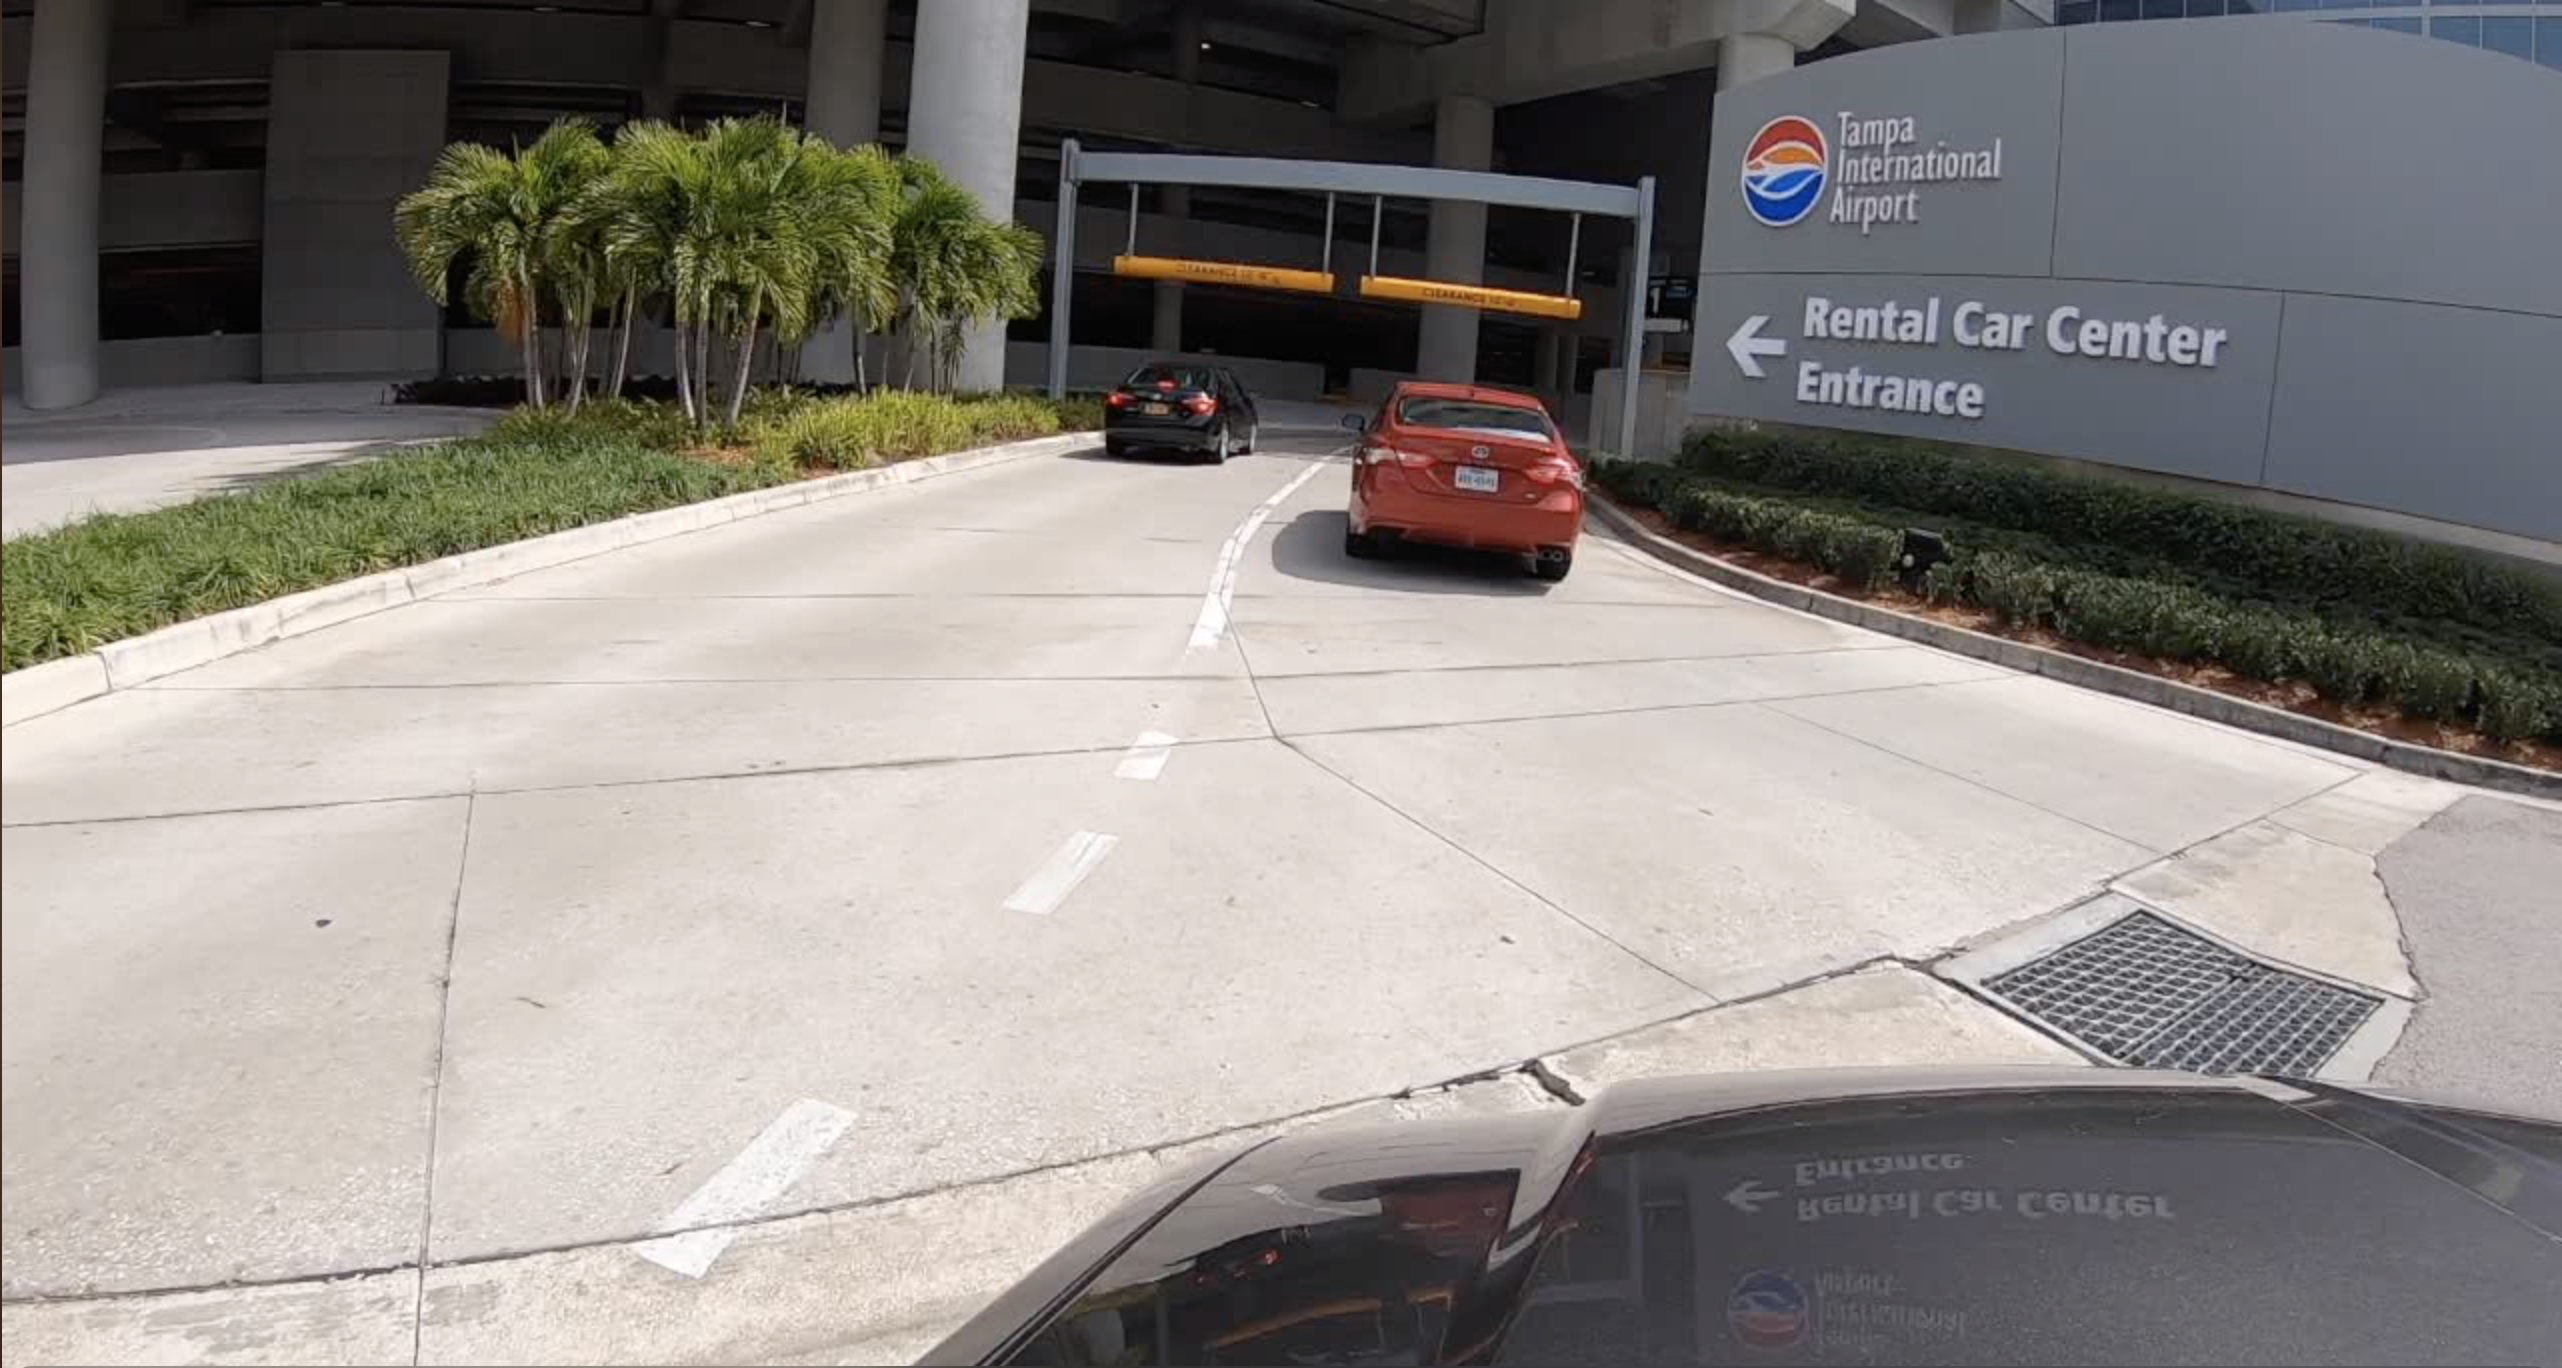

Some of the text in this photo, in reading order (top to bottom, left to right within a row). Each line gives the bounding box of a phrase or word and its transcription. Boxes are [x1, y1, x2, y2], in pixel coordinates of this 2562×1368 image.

[1838, 112, 1914, 155] Tampa
[1837, 138, 2001, 184] International
[1829, 186, 1919, 234] Airport
[1804, 297, 2227, 367] Rental Car Center
[1797, 361, 1985, 418] Entrance
